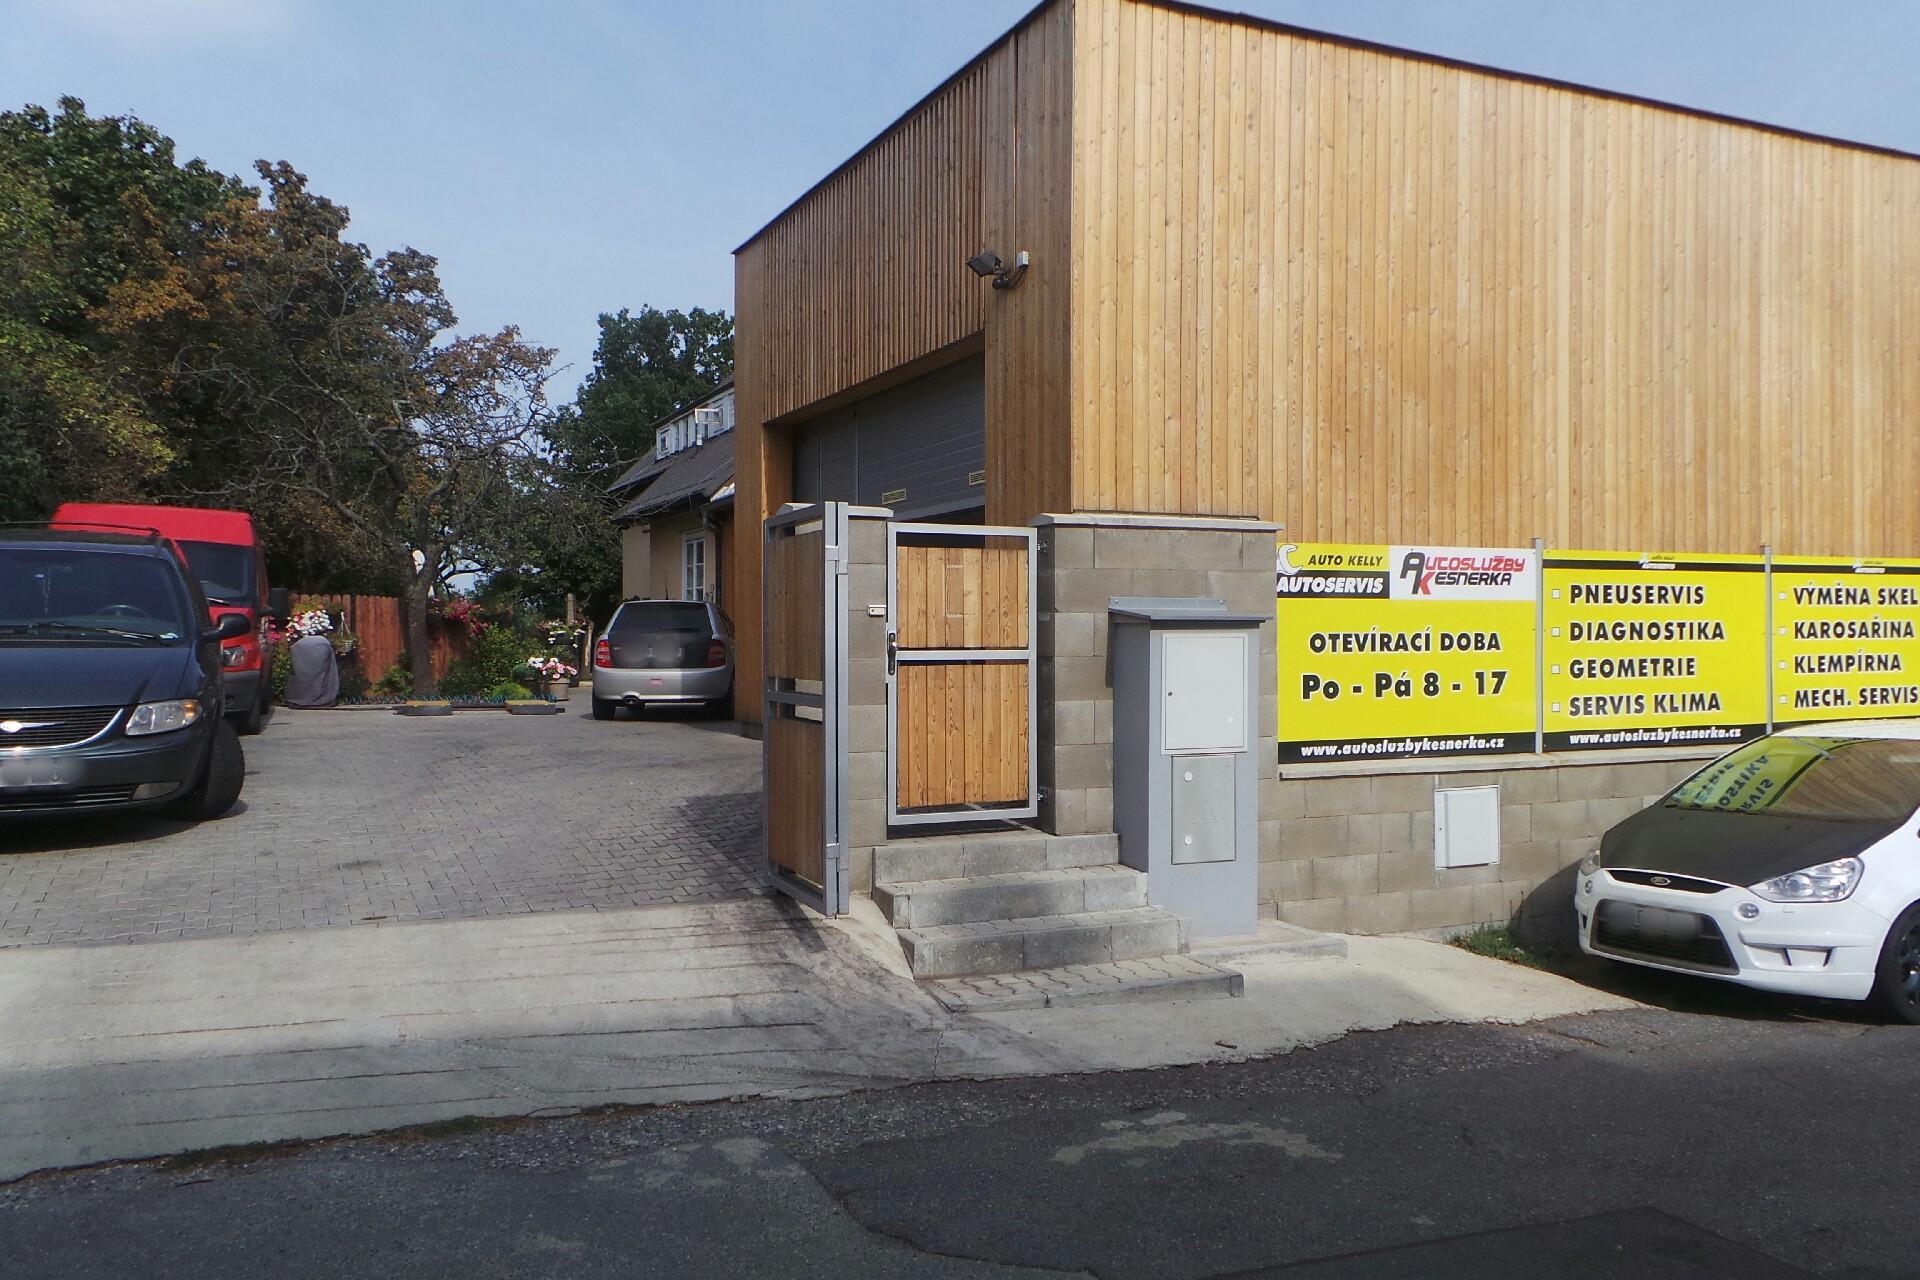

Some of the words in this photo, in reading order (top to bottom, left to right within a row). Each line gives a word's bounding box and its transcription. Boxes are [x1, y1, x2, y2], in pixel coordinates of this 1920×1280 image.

[1308, 554, 1344, 566] AUTO
[1347, 555, 1384, 566] KELLY
[1277, 576, 1384, 593] AUTOSERVIS
[1569, 584, 1705, 605] PNEUSERVIS
[1793, 581, 1871, 606] VÝMĚNA
[1878, 588, 1919, 606] SKEL
[1569, 621, 1725, 642] DIAGNOSTIKA
[1794, 615, 1915, 640] KAROSAŘINA
[1309, 626, 1431, 653] OTEVÍRACÍ
[1440, 632, 1501, 652] DOBA
[1569, 657, 1696, 679] GEOMETRIE
[1794, 648, 1902, 674] KLEMPÍRNA
[1301, 673, 1340, 700] Po
[1352, 685, 1362, 694] -
[1374, 671, 1412, 698] Pá
[1423, 672, 1440, 697] 8
[1451, 683, 1461, 691] -
[1475, 671, 1508, 695] 17
[1569, 694, 1645, 717] SERVIS
[1653, 692, 1721, 714] KLIMA
[1794, 688, 1851, 709] MECH.
[1859, 686, 1919, 706] SERVIS
[1301, 735, 1505, 757] www.autosluzbykesnerka.cz
[1569, 727, 1742, 745] www.autosluzbykesnerka.cz
